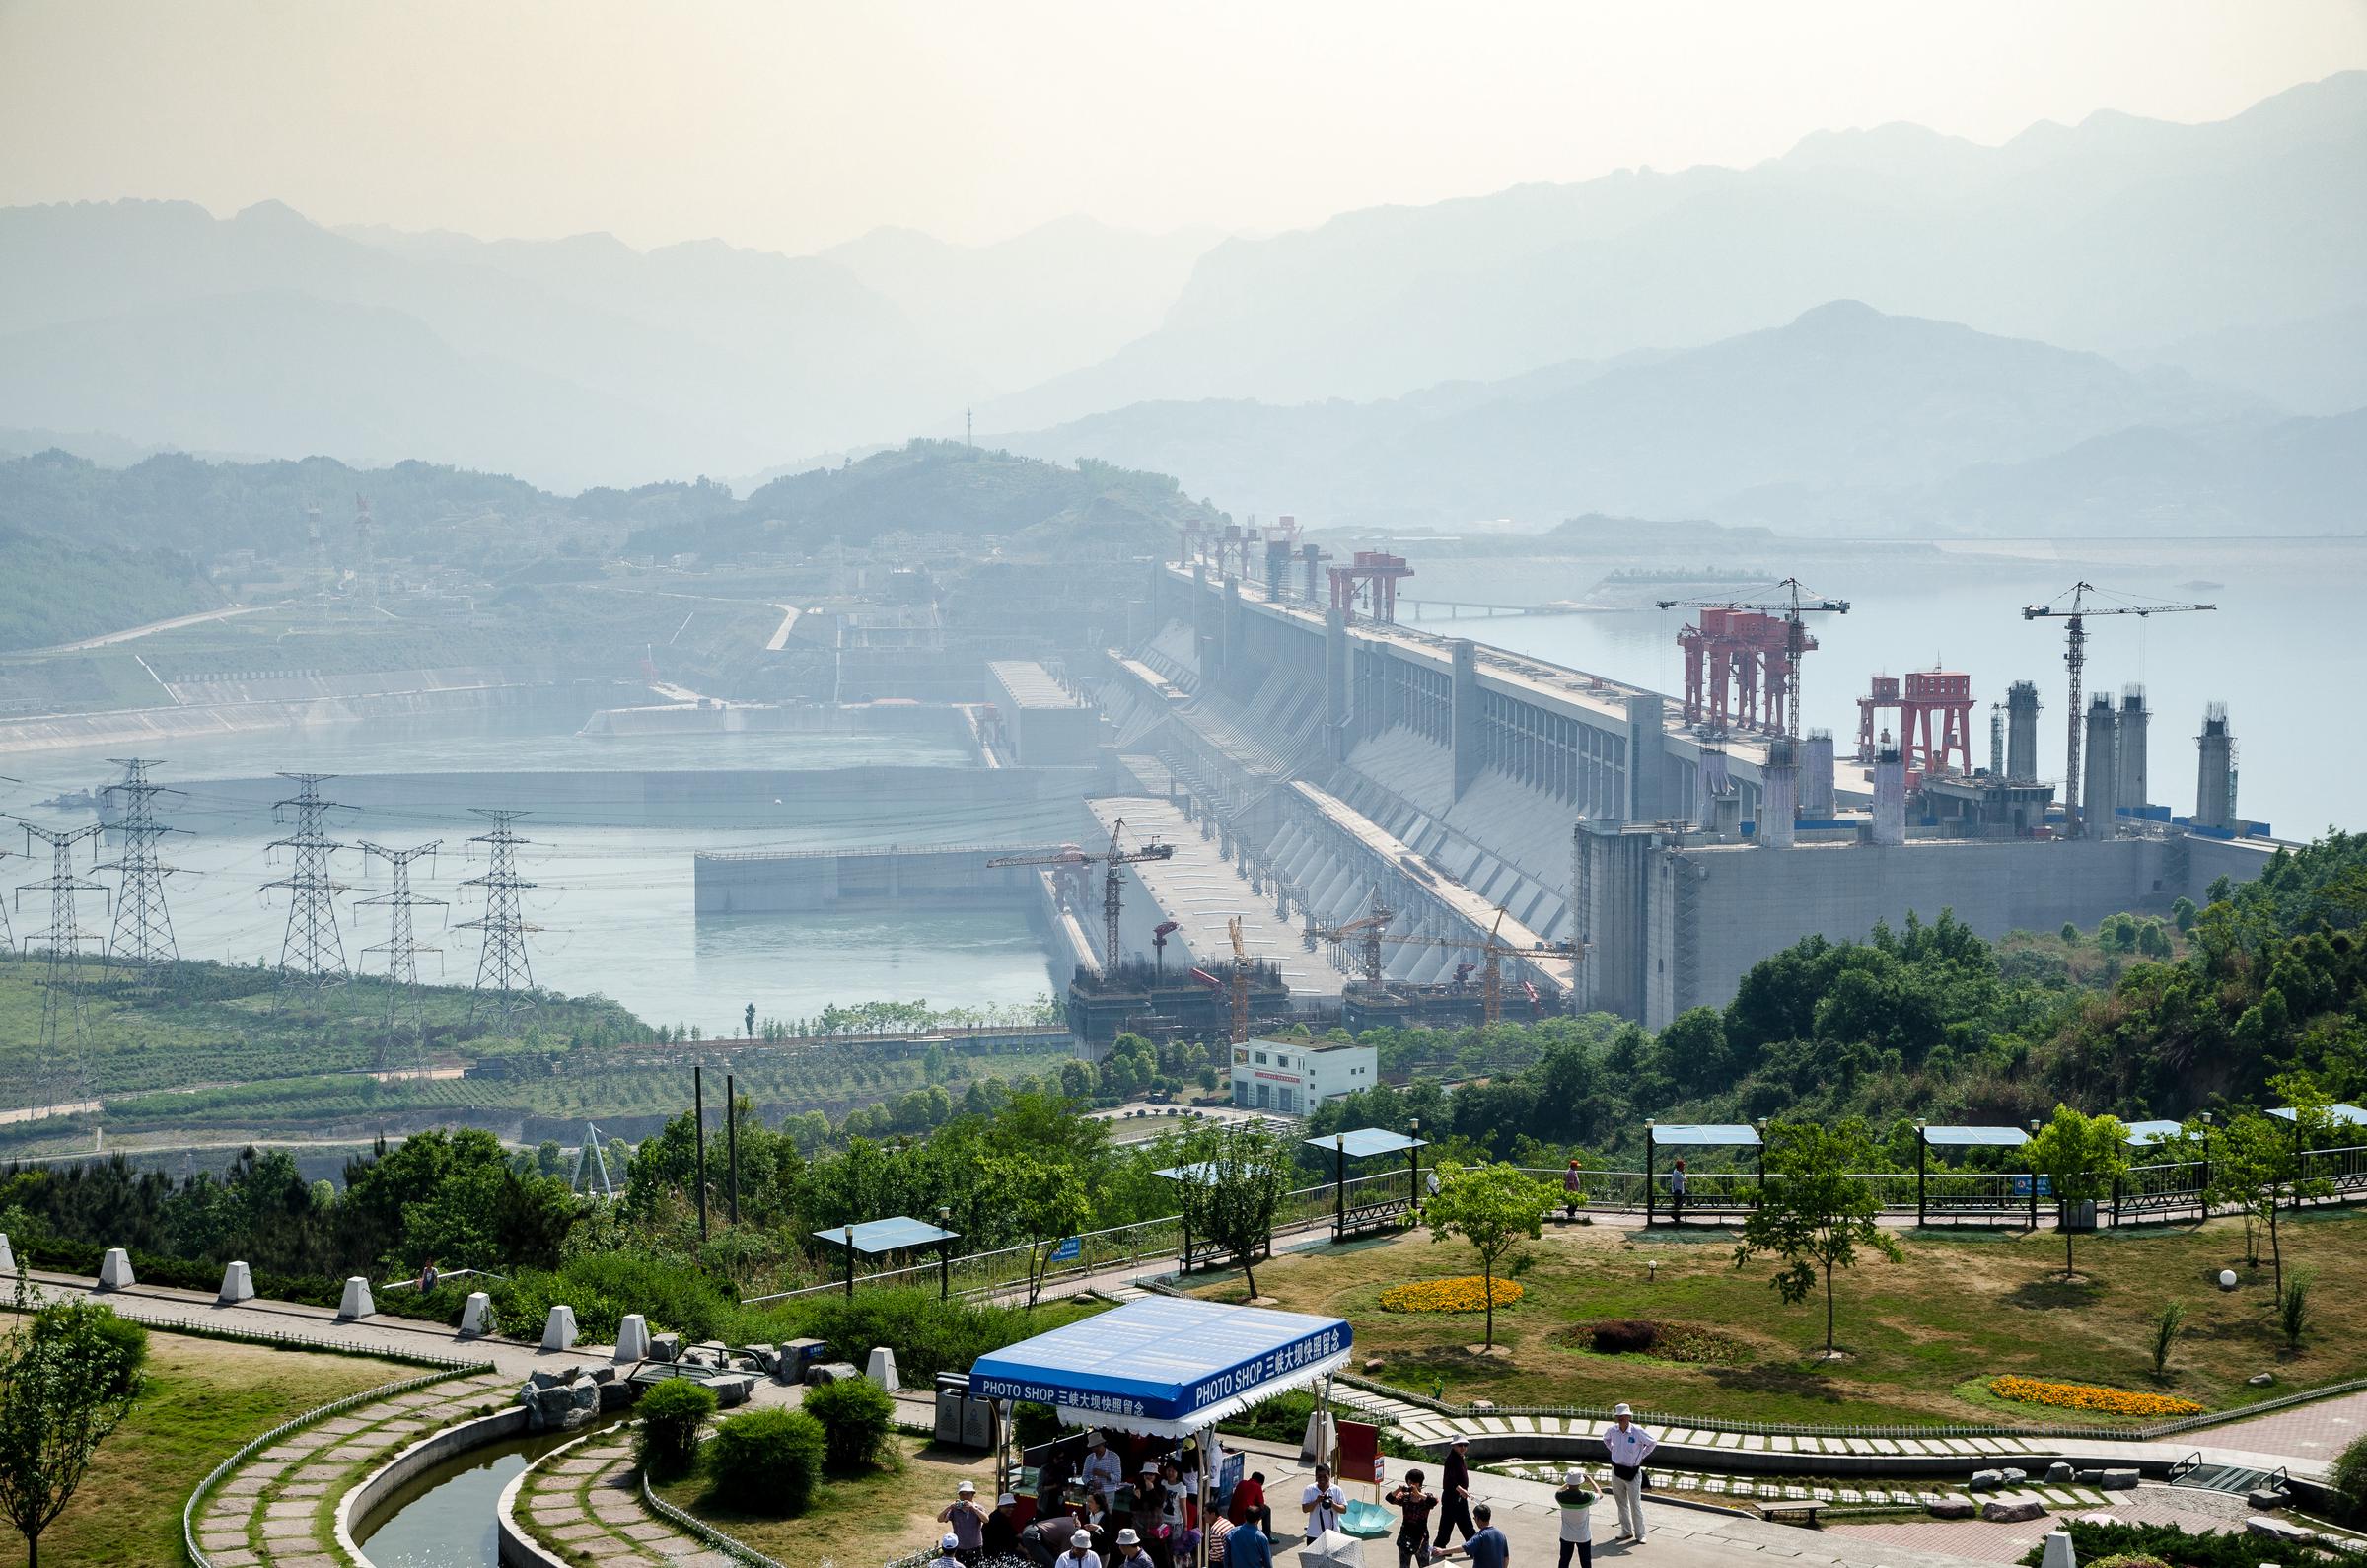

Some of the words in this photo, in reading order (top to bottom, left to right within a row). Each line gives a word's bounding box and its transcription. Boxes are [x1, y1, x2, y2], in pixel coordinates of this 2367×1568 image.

[1196, 1374, 1232, 1407] PHOTO
[1235, 1361, 1263, 1390] SHOP
[1265, 1328, 1340, 1378] 三峡大坝快照留念
[983, 1380, 1021, 1397] PHOTO
[1024, 1386, 1054, 1402] SHOP
[1058, 1390, 1144, 1416] 三峡大坝快照留念
